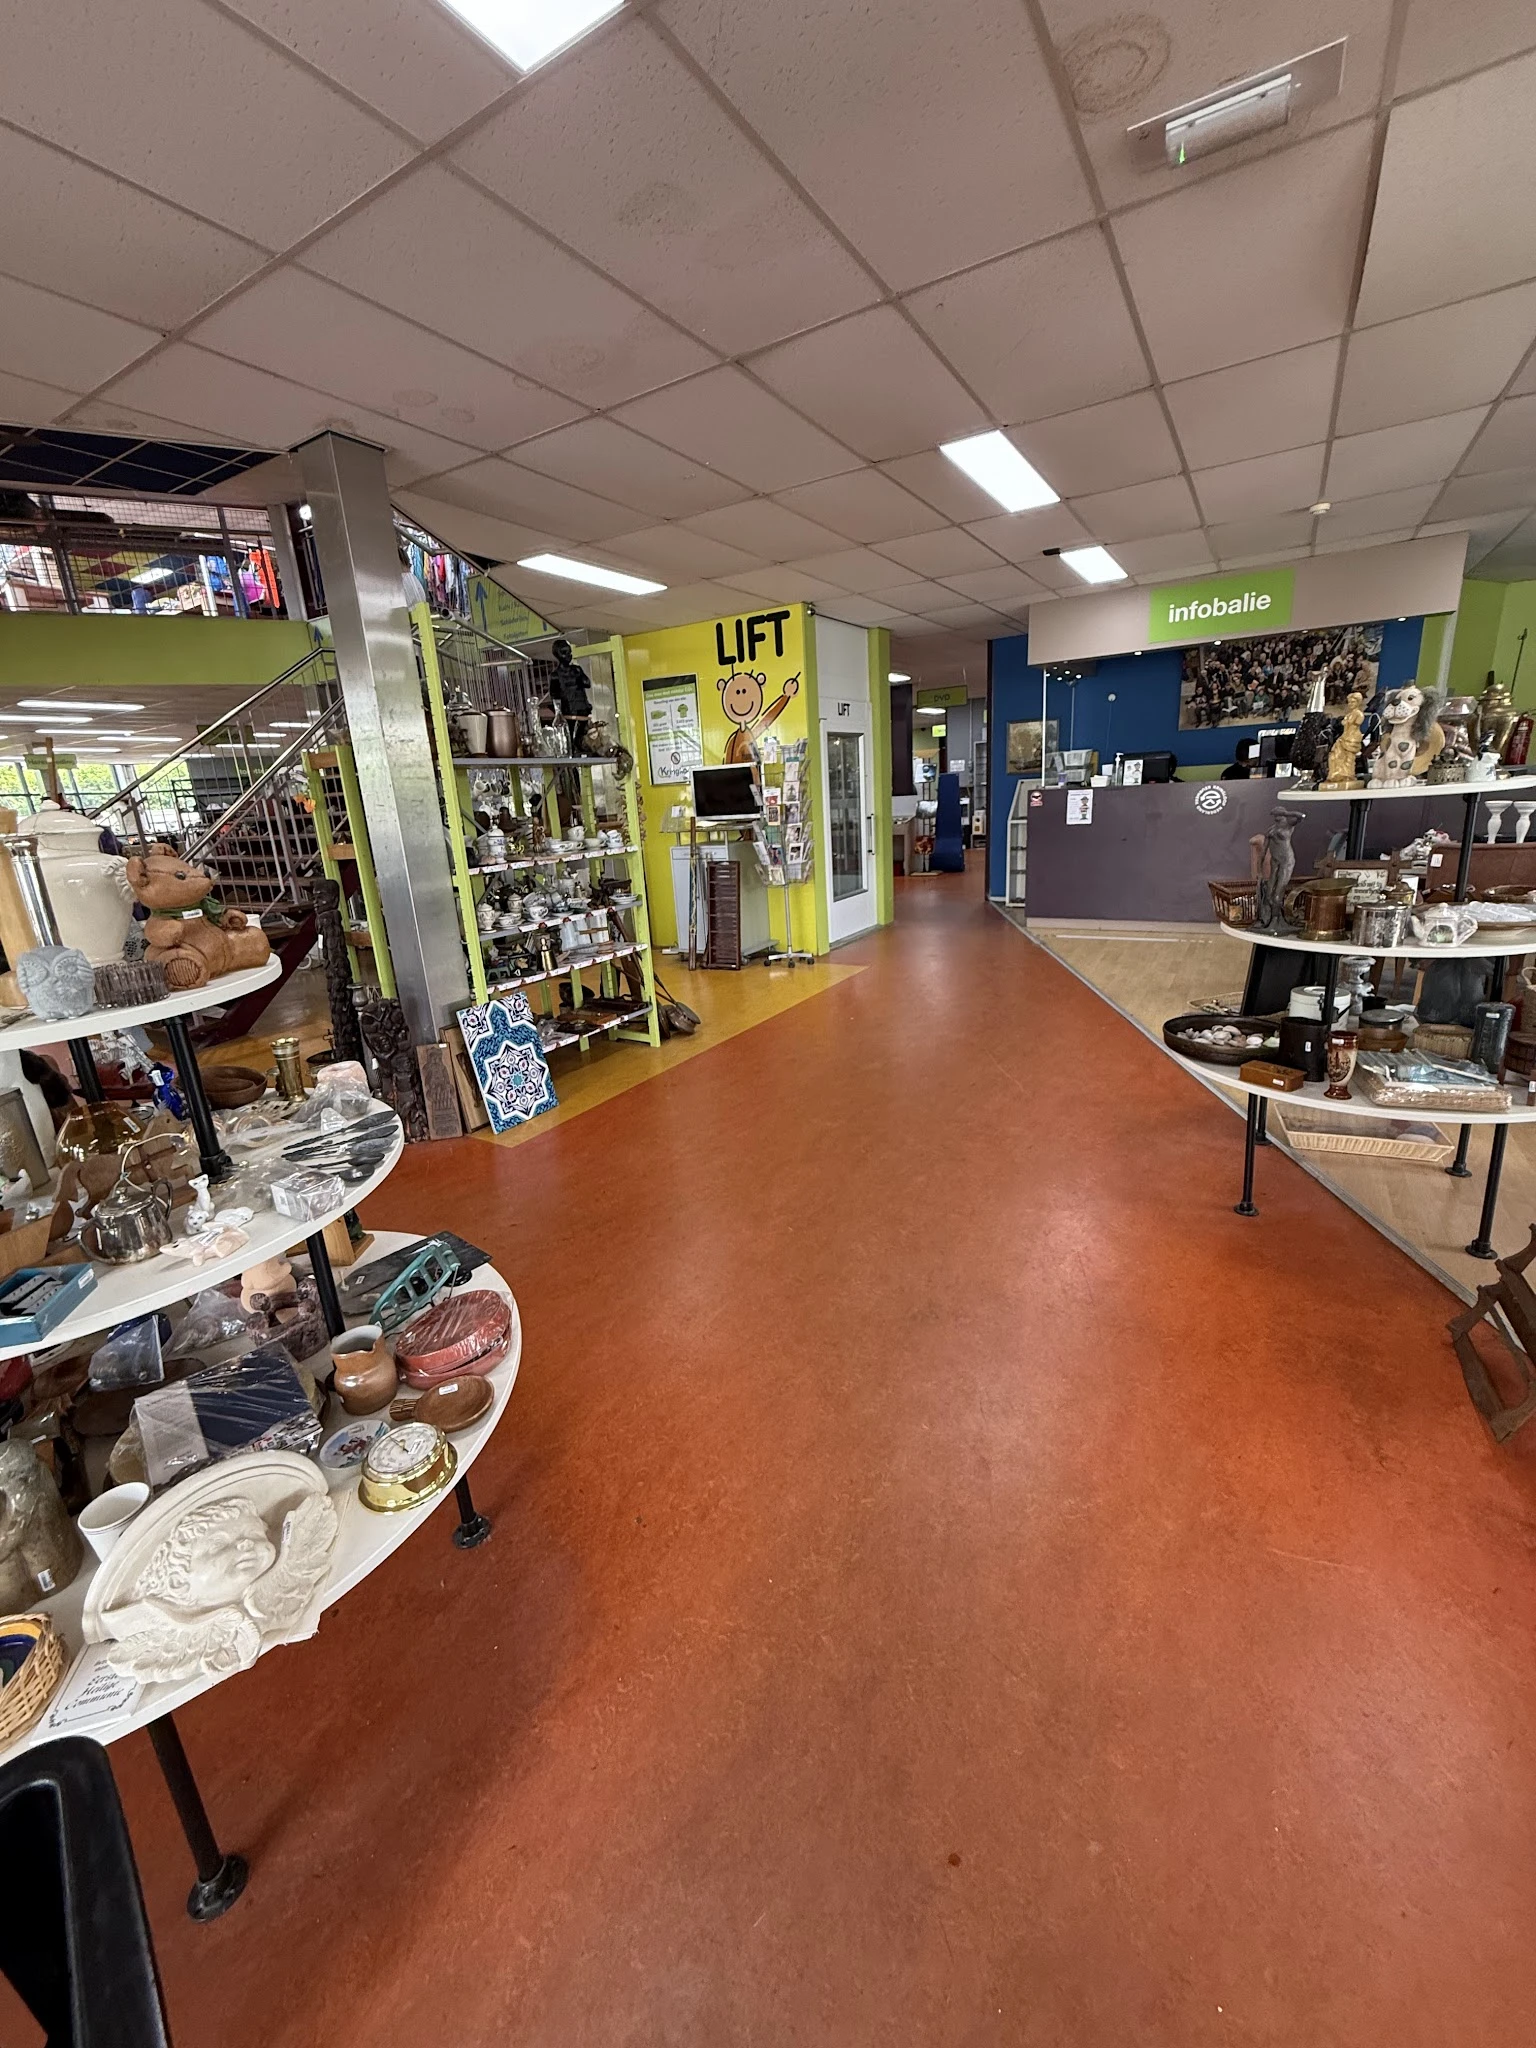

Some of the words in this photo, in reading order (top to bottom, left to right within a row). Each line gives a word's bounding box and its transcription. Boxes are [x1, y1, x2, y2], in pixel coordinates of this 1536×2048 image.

[1168, 591, 1272, 624] infobalie
[716, 610, 791, 666] LIFT
[837, 702, 850, 717] LIFT
